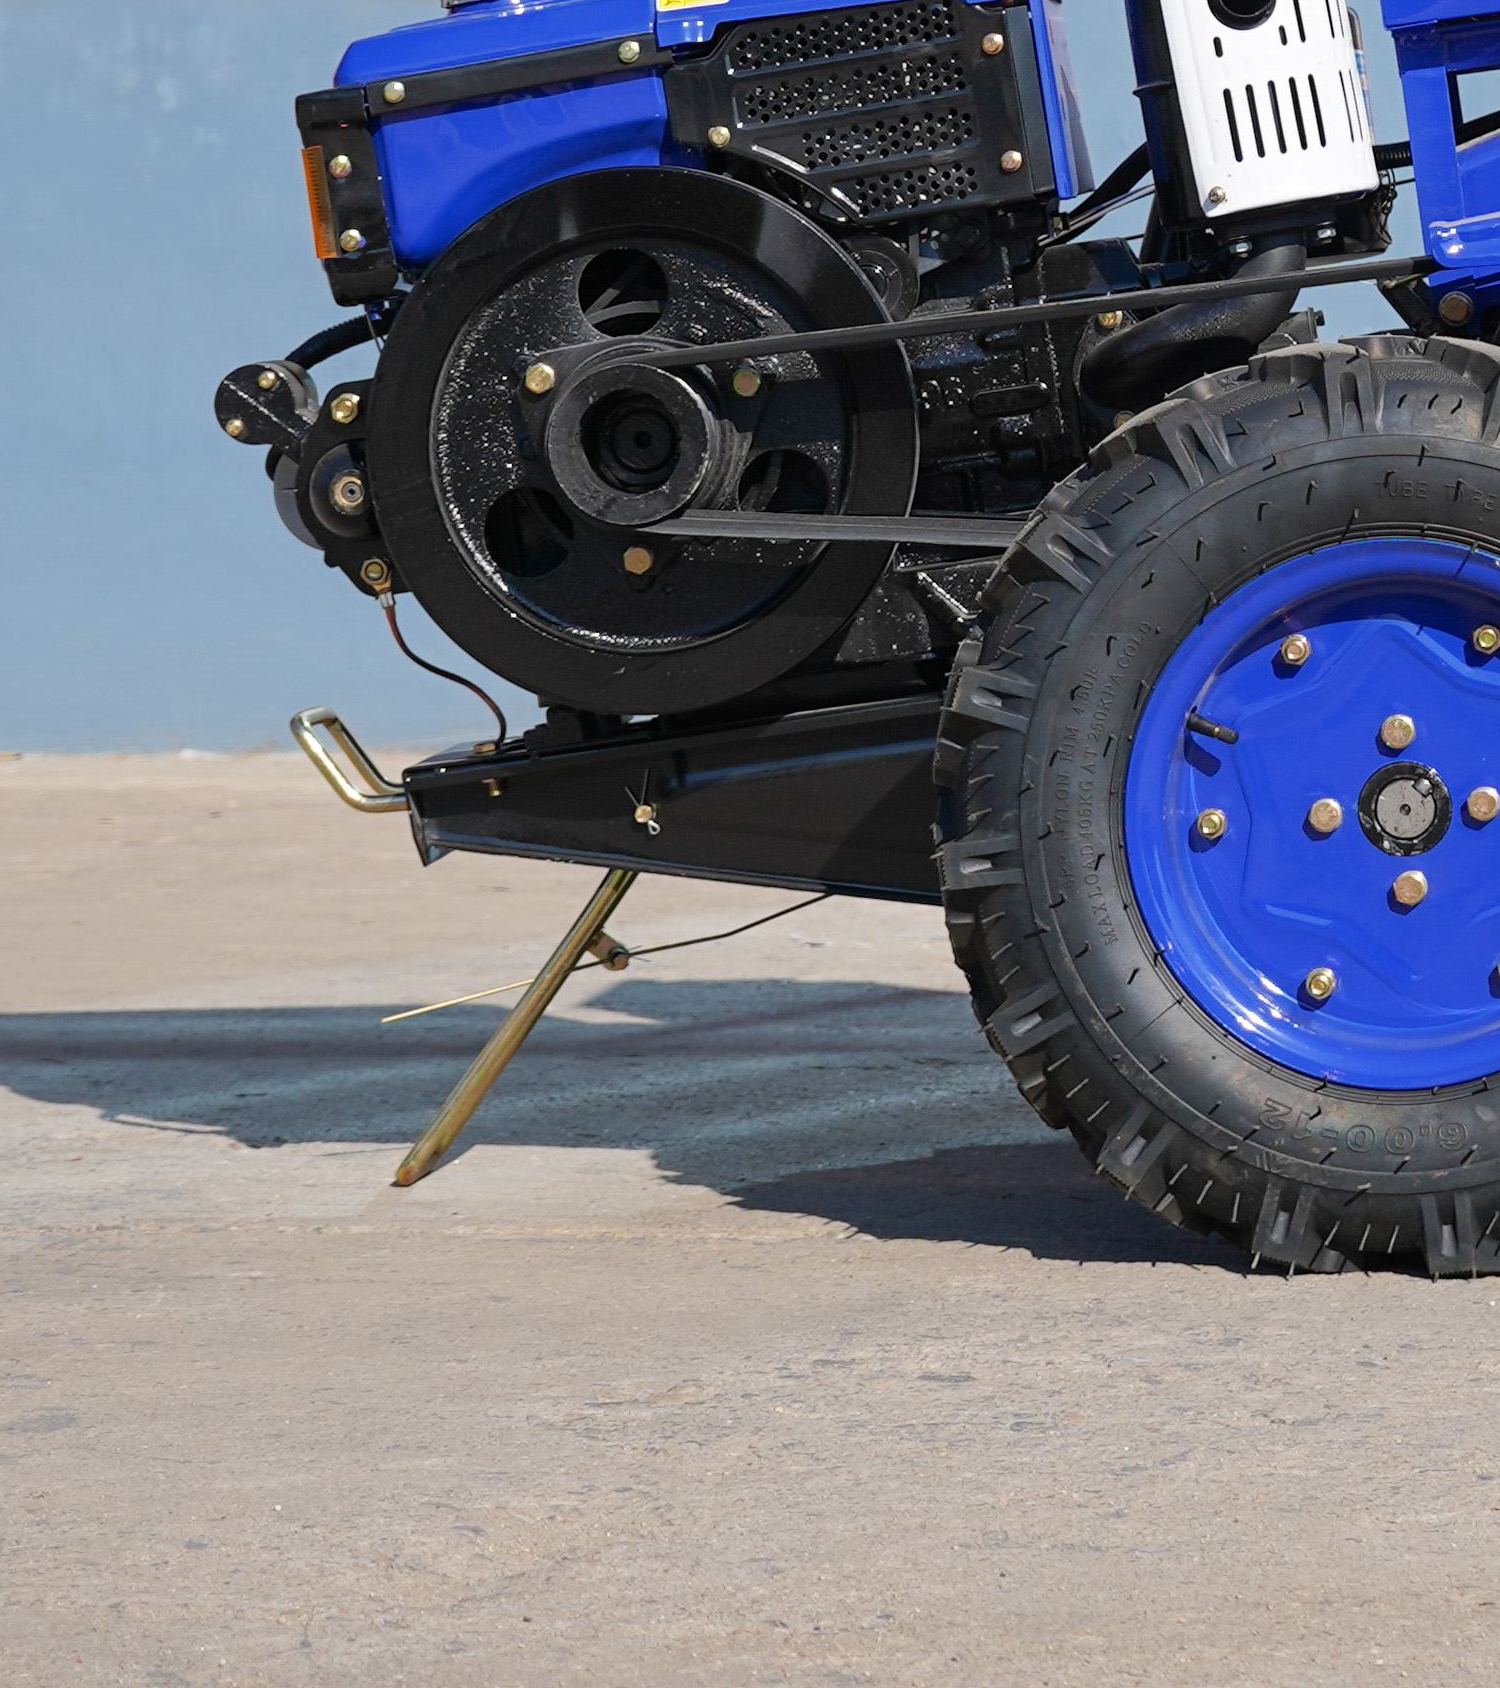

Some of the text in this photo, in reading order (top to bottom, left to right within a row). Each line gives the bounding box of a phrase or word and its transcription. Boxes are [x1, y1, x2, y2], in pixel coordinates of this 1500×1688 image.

[1374, 480, 1428, 499] TUBE
[1092, 900, 1119, 947] MAX
[1258, 1097, 1469, 1156] 6.00-12
